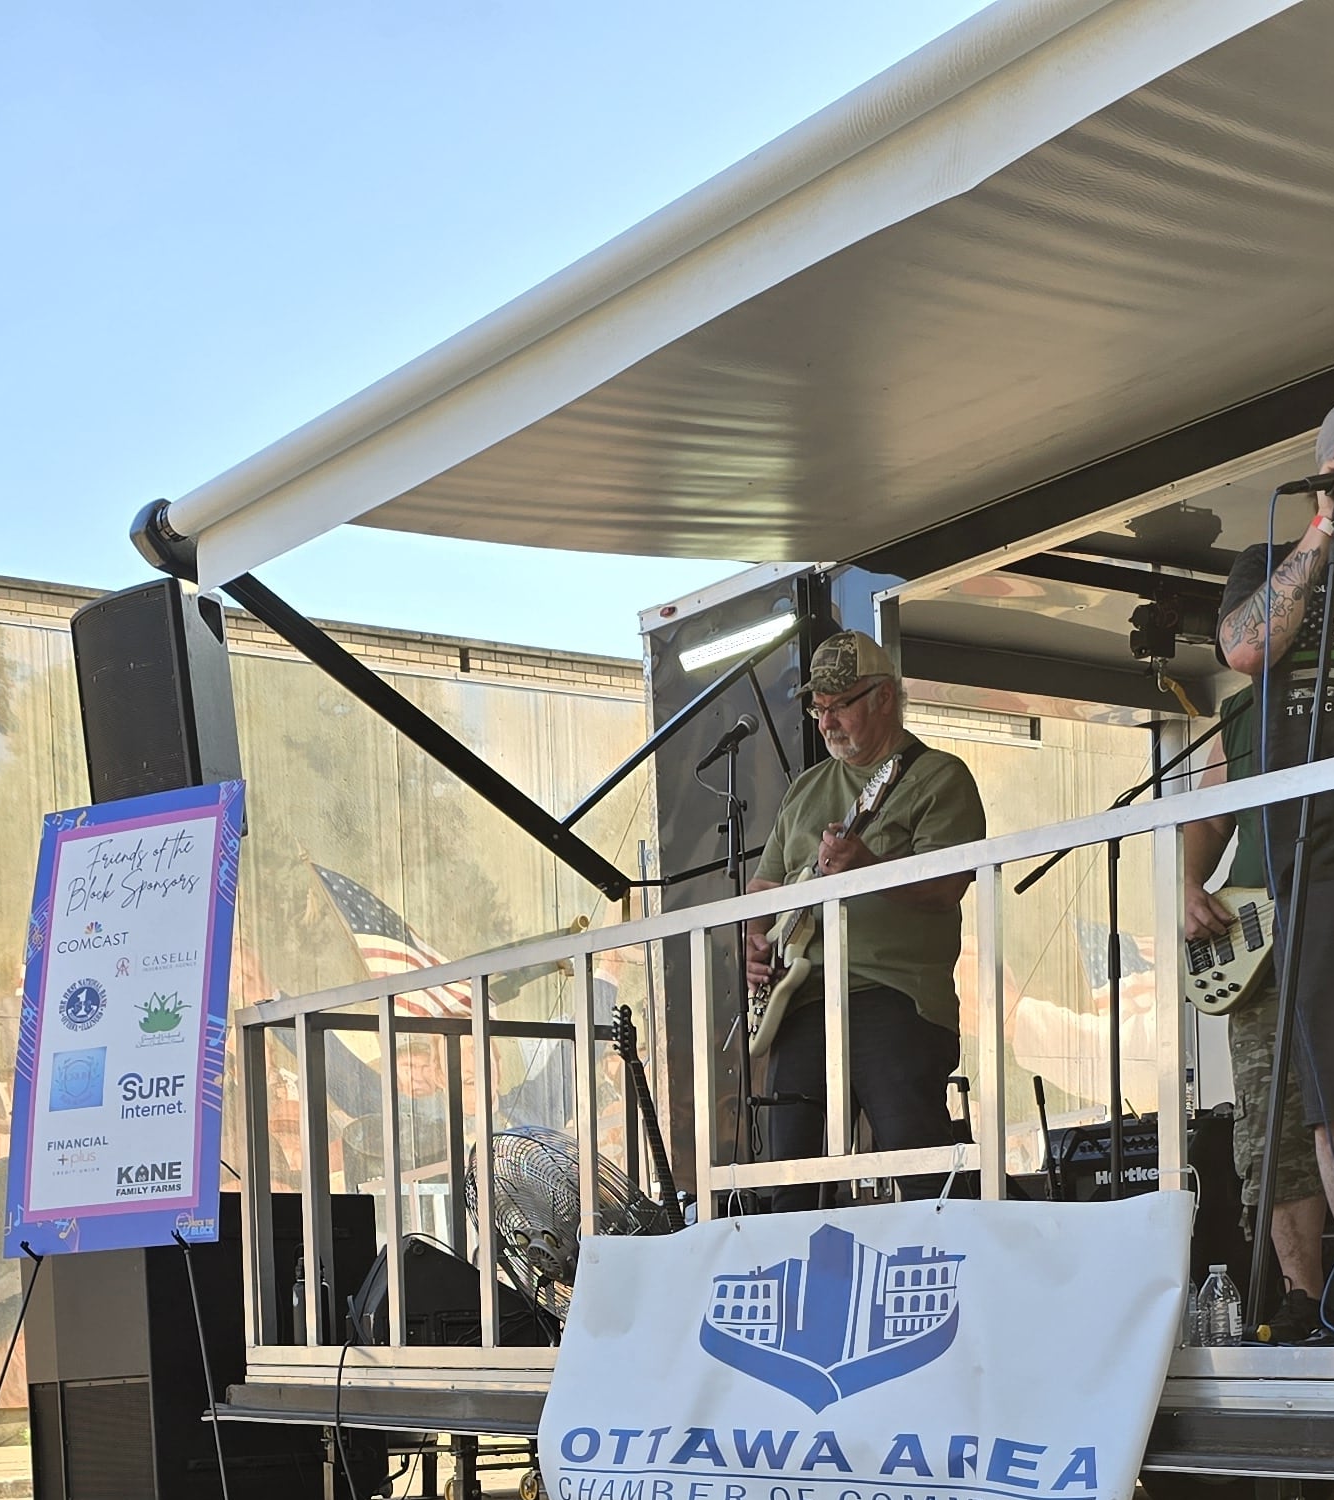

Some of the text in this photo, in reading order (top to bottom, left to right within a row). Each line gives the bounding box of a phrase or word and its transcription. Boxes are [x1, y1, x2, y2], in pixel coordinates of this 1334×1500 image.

[86, 838, 149, 880] Friends
[167, 829, 195, 869] the
[66, 868, 200, 917] Block Sponsors
[57, 931, 129, 954] COMCAST
[142, 950, 198, 967] CASELLI
[122, 1075, 185, 1101] SURF
[121, 1100, 187, 1119] Internet.
[47, 1136, 109, 1151] FINANCIAL
[117, 1161, 182, 1185] KANE
[116, 1183, 182, 1196] FAMILY FARMS
[559, 1424, 1099, 1491] OTTAWA AREA
